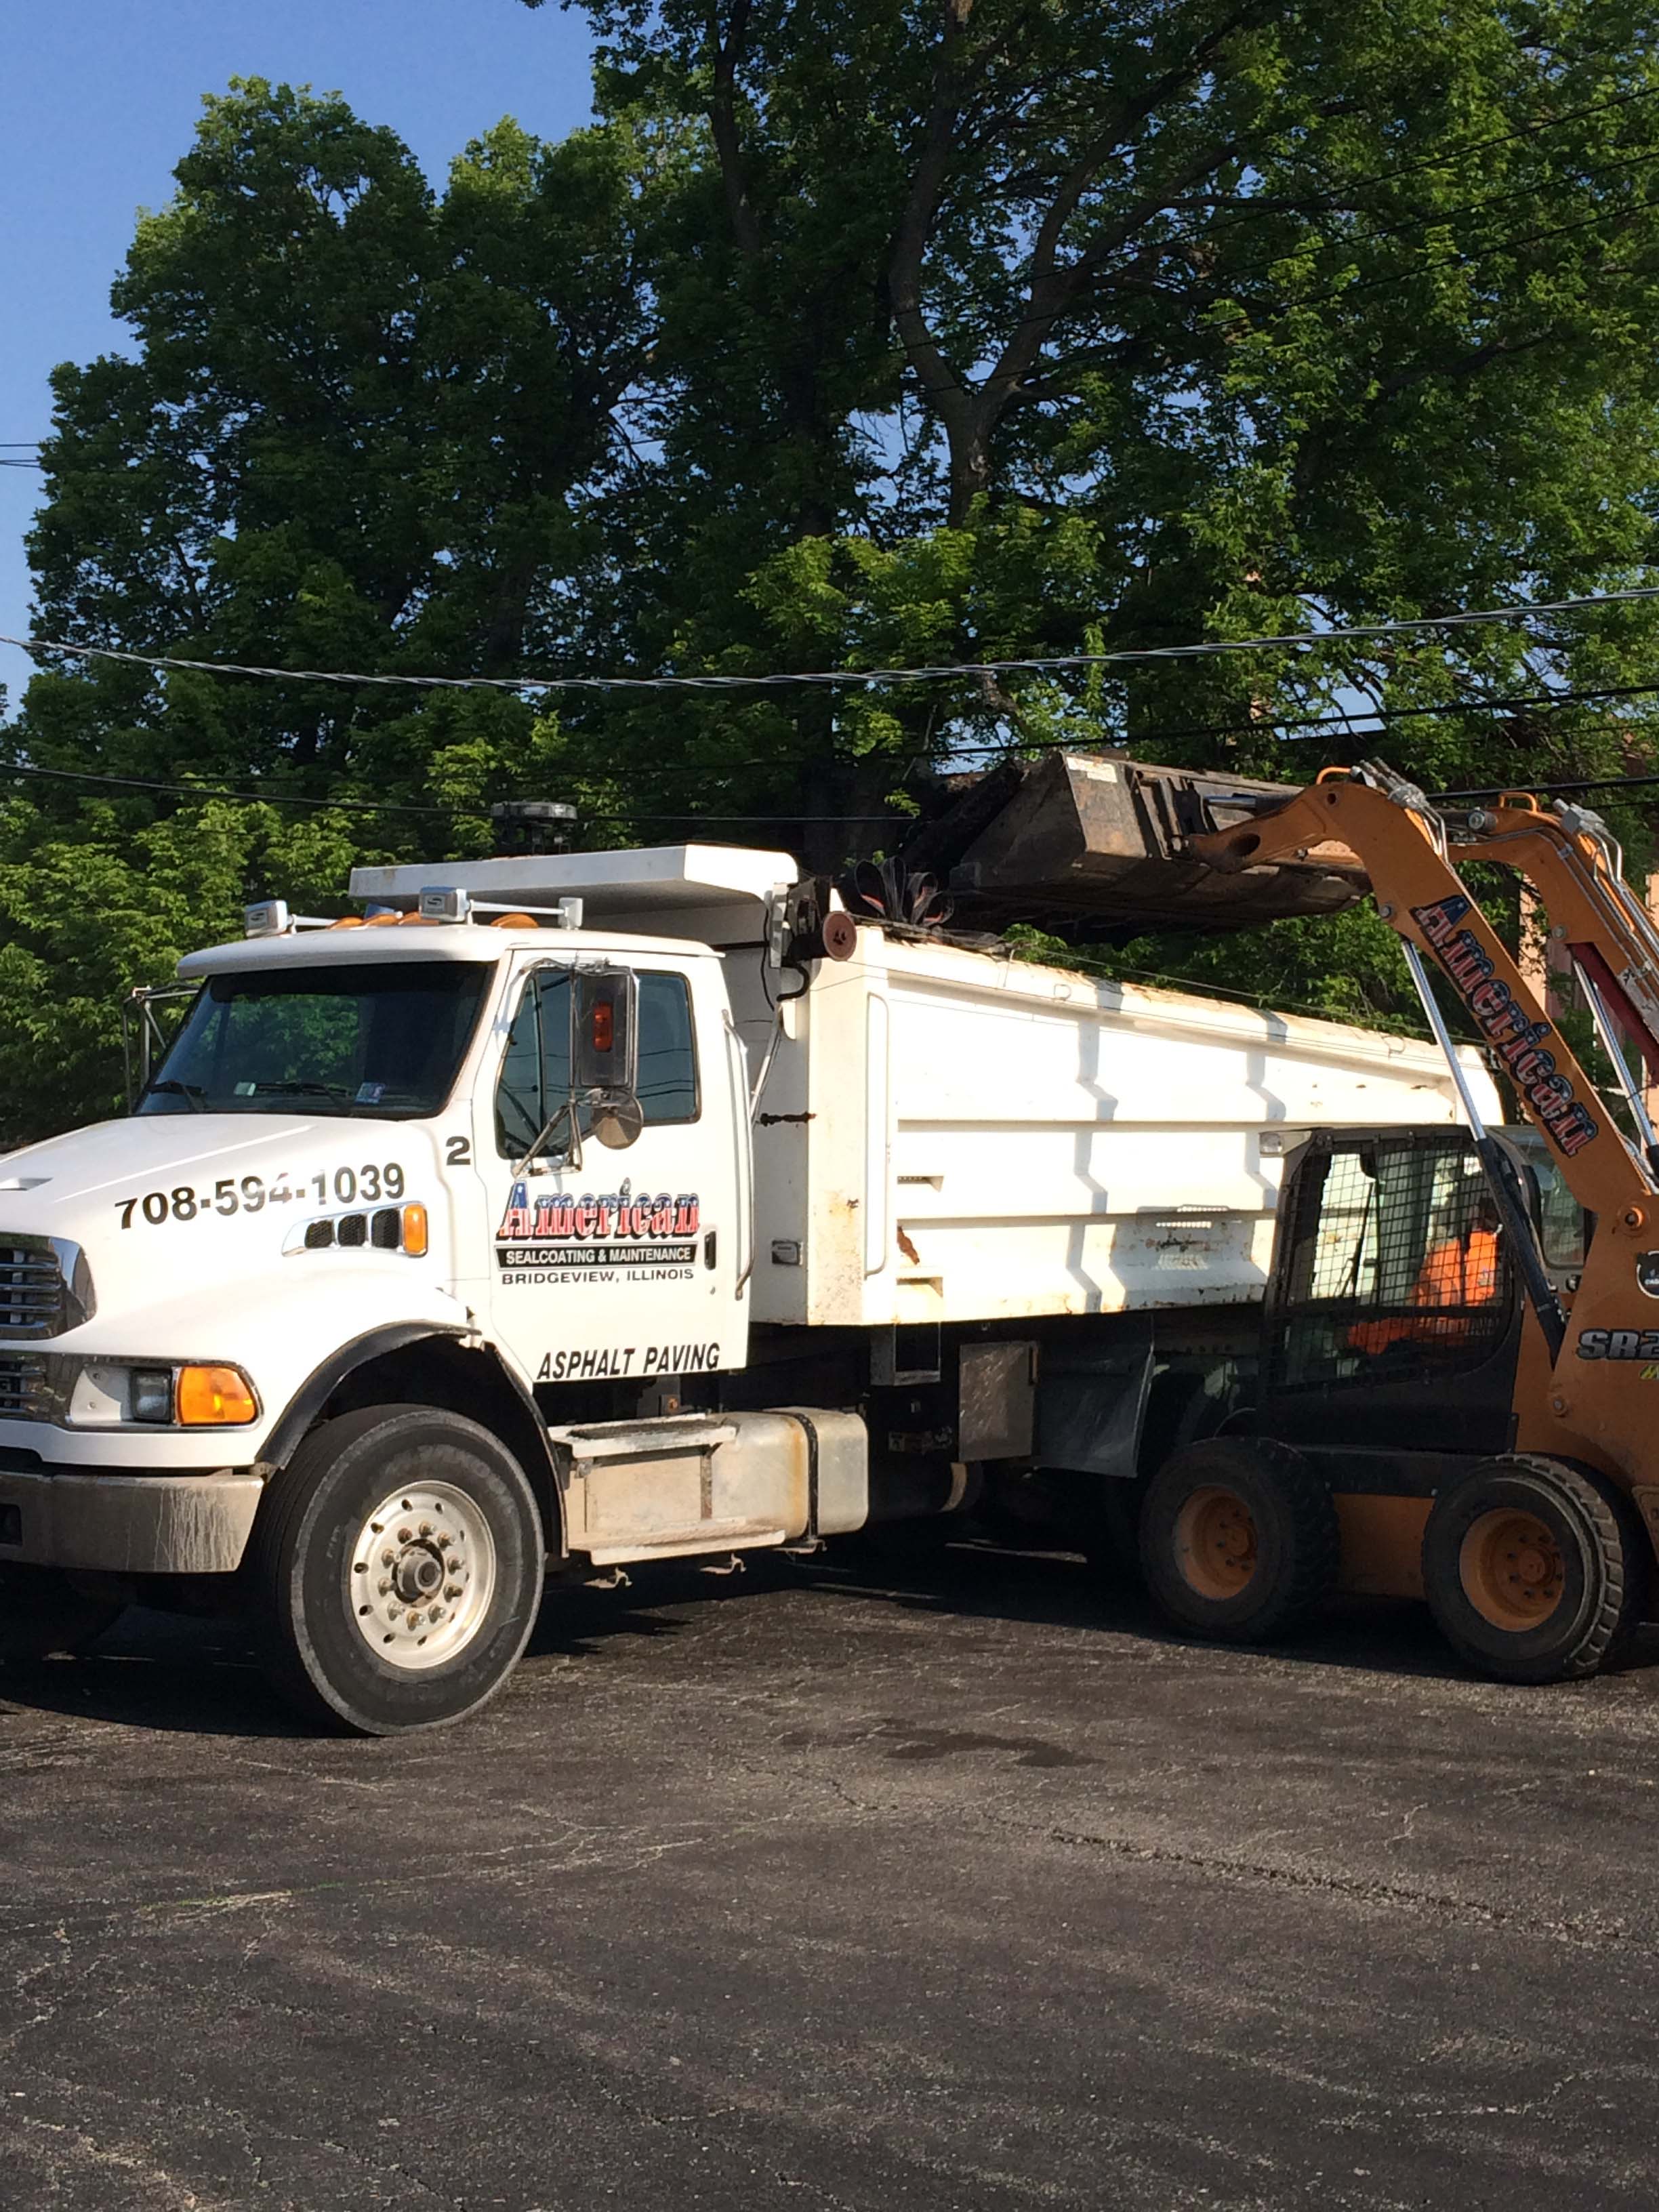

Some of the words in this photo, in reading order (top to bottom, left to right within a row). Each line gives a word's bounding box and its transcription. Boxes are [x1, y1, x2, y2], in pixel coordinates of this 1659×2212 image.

[1409, 894, 1599, 1158] American
[445, 1136, 471, 1166] 2
[114, 1162, 405, 1229] 708-594-1039
[496, 1177, 699, 1241] American
[506, 1250, 595, 1265] SEALCOATING
[598, 1250, 607, 1263] &
[609, 1246, 691, 1262] MAINTENANCE
[501, 1271, 619, 1285] BRIDGEVIEW,
[627, 1268, 694, 1281] ILLINOIS
[537, 1348, 636, 1380] ASPHALT
[642, 1342, 720, 1374] PAVING
